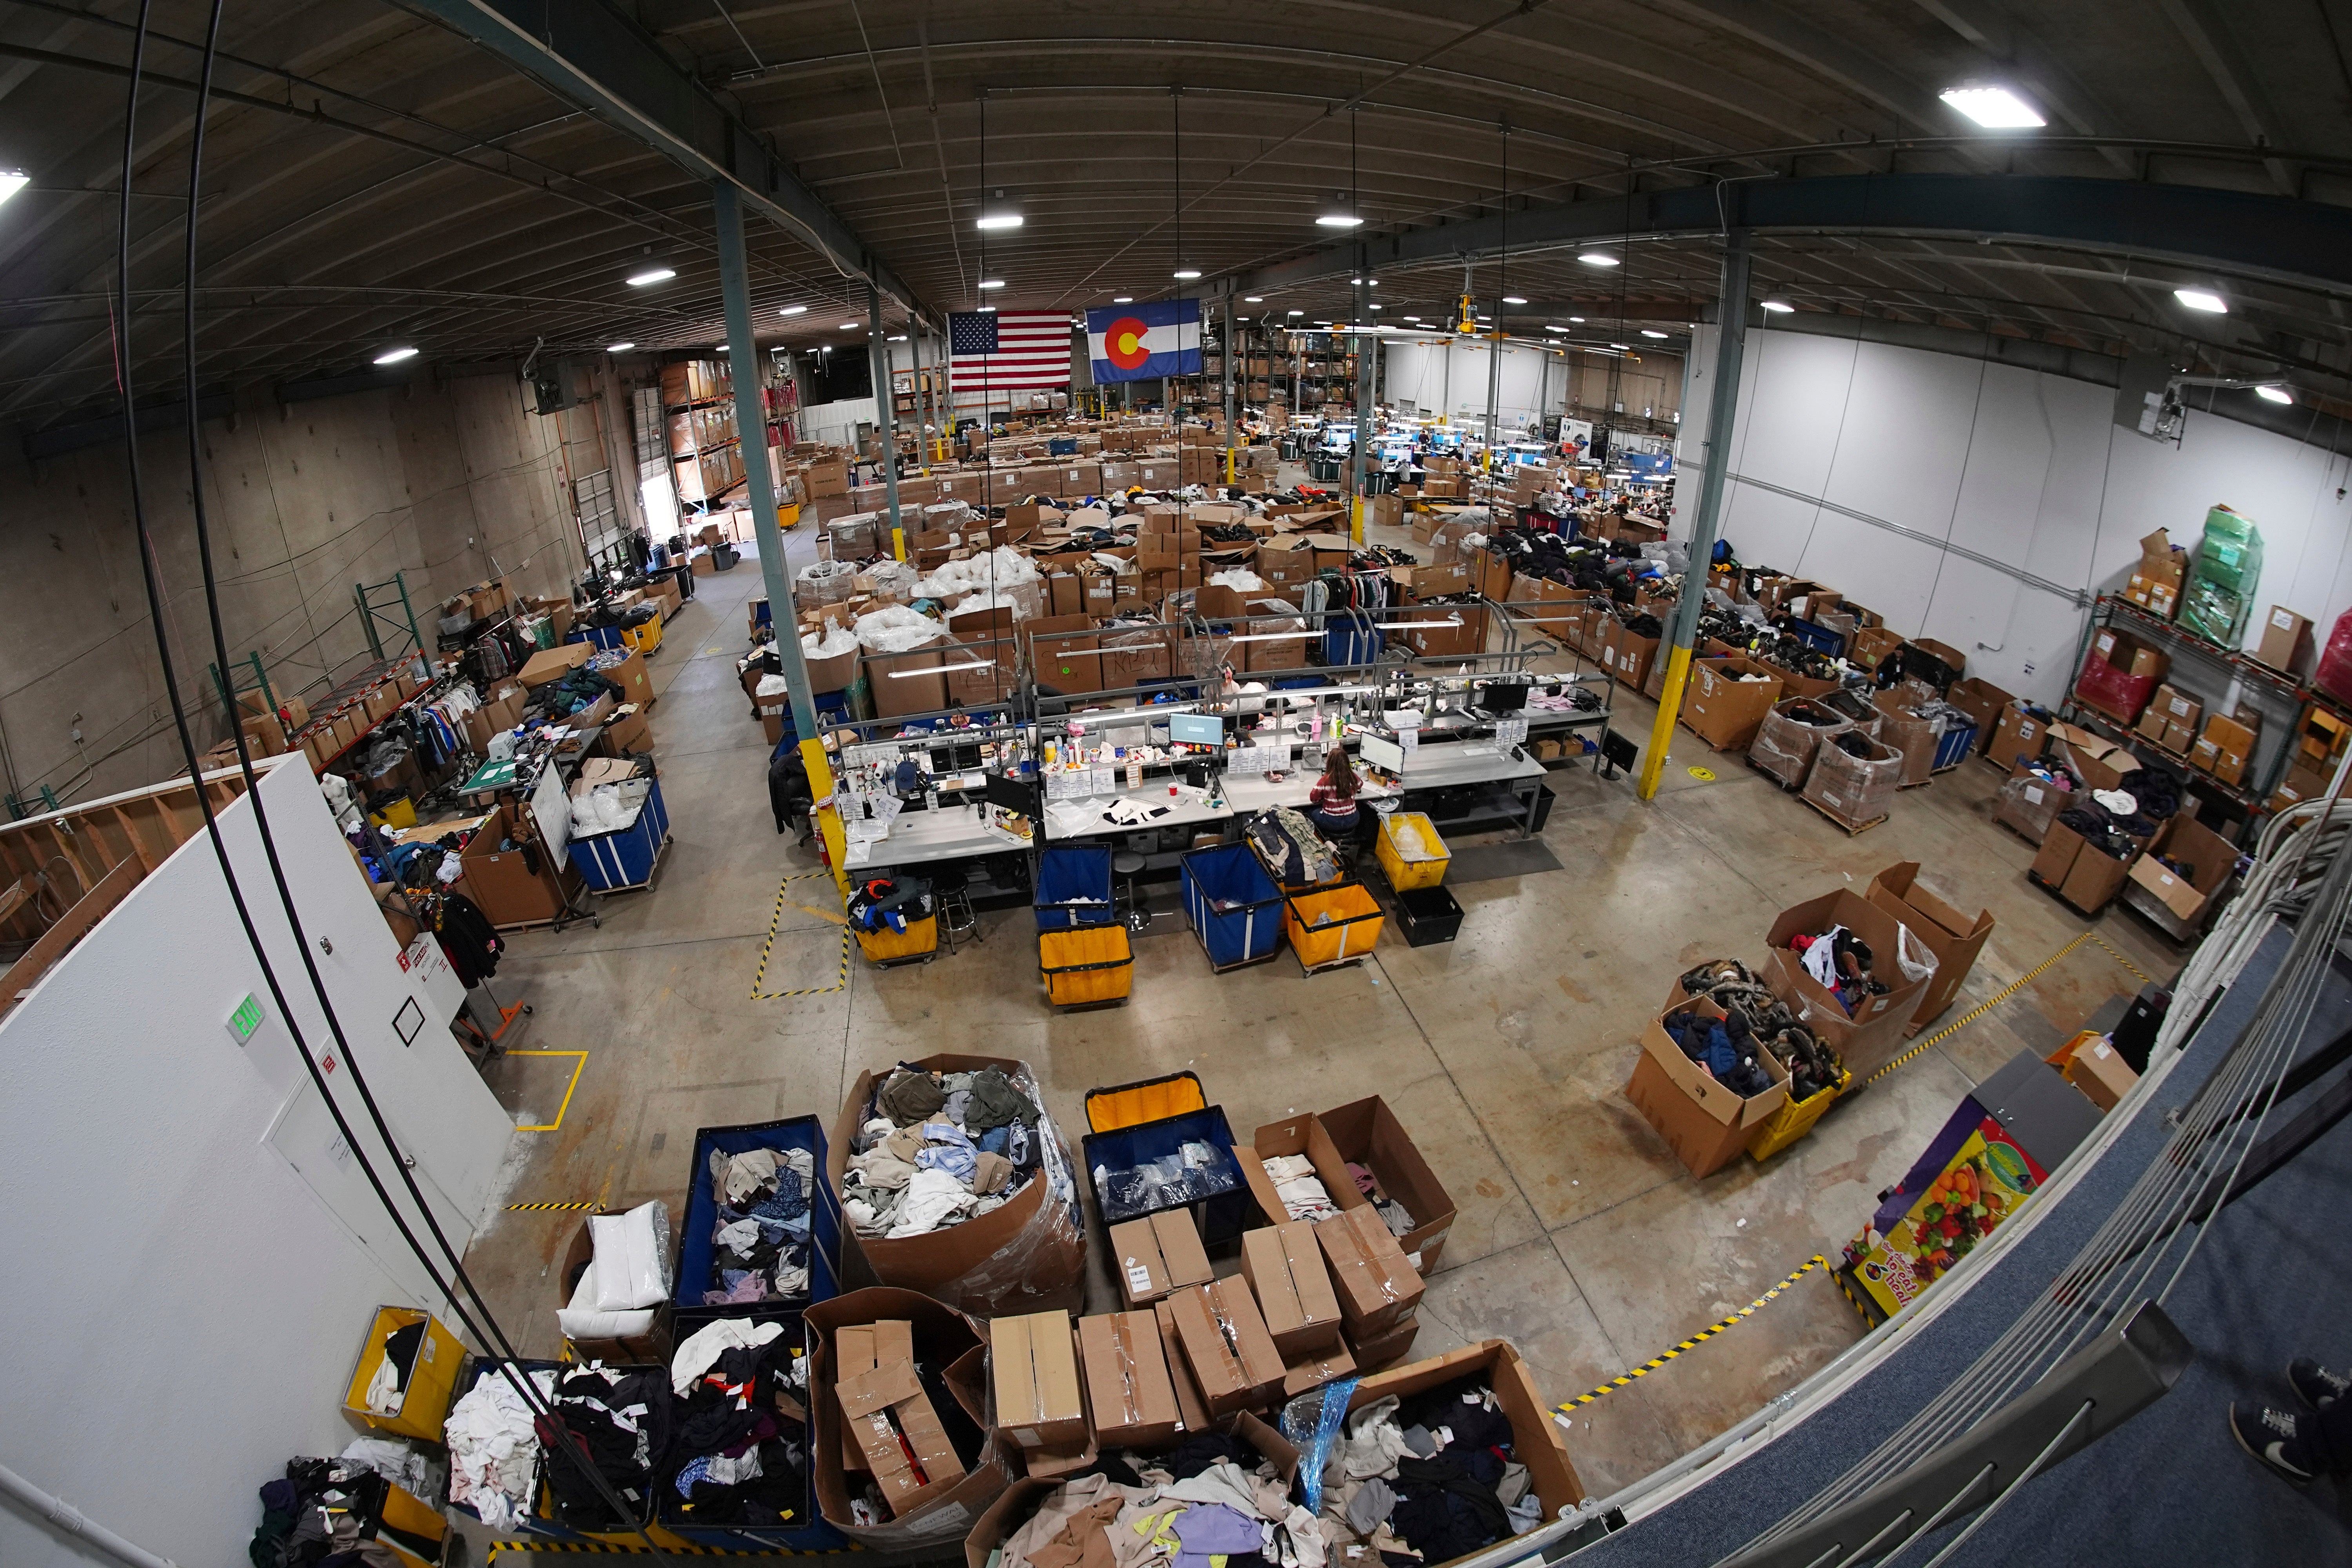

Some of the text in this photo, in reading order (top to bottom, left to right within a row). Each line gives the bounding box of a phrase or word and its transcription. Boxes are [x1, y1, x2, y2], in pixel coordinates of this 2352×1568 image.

[886, 799, 897, 807] OTHER
[413, 955, 421, 967] First
[232, 996, 262, 1037] EXIT
[1885, 1256, 1917, 1292] to eat
[1886, 1272, 1913, 1308] heal
